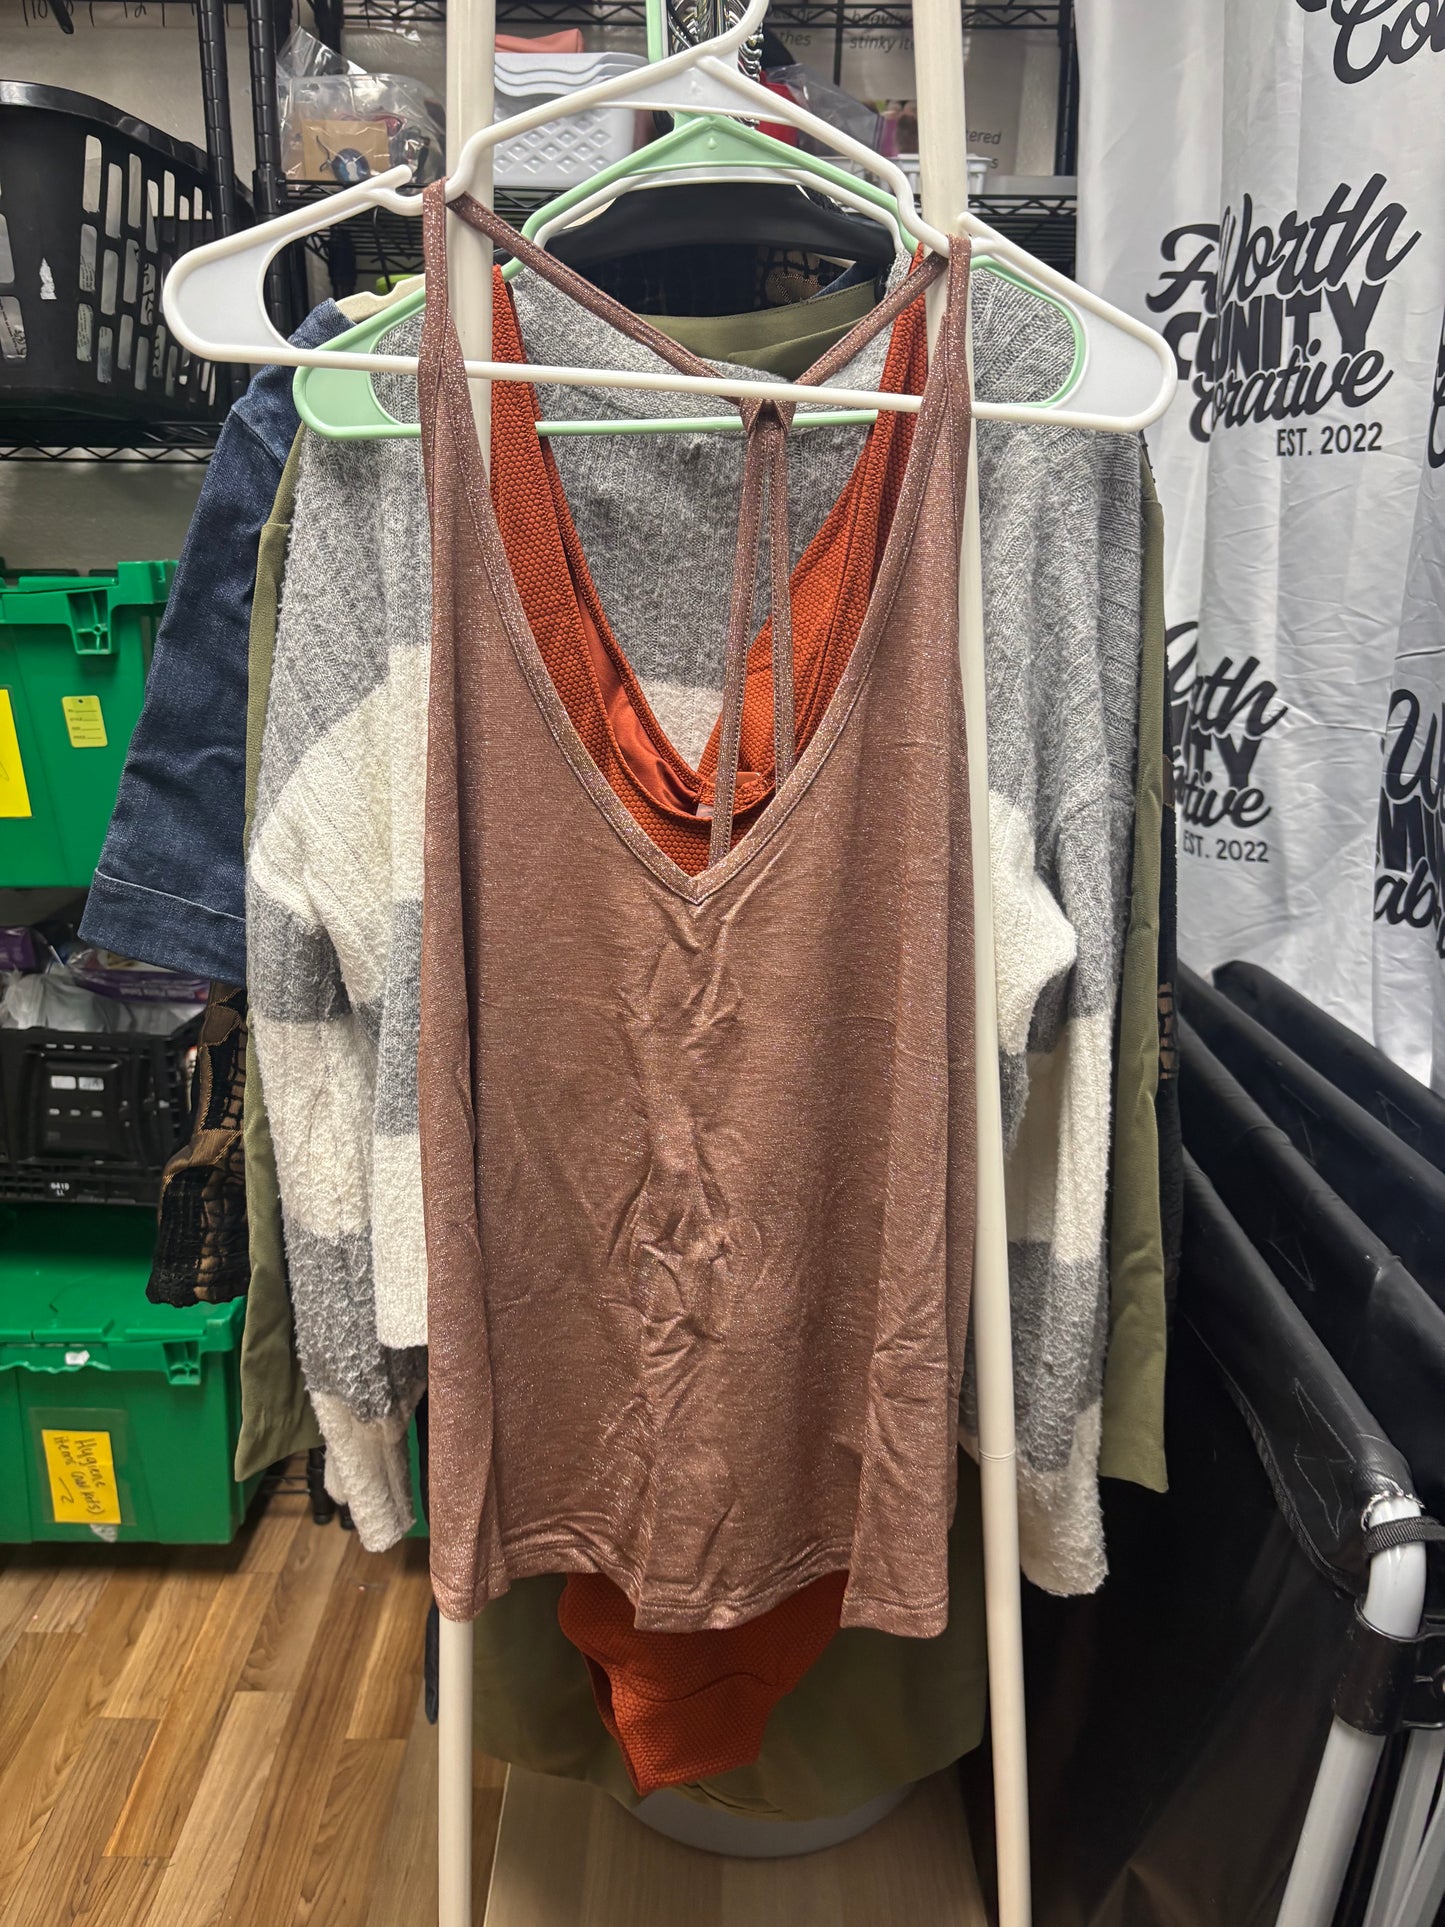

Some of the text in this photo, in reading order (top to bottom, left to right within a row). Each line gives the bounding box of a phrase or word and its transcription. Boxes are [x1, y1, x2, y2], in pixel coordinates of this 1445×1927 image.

[850, 34, 896, 53] stinky
[1277, 422, 1383, 456] EST. 2022
[1182, 829, 1270, 863] EST. 2022
